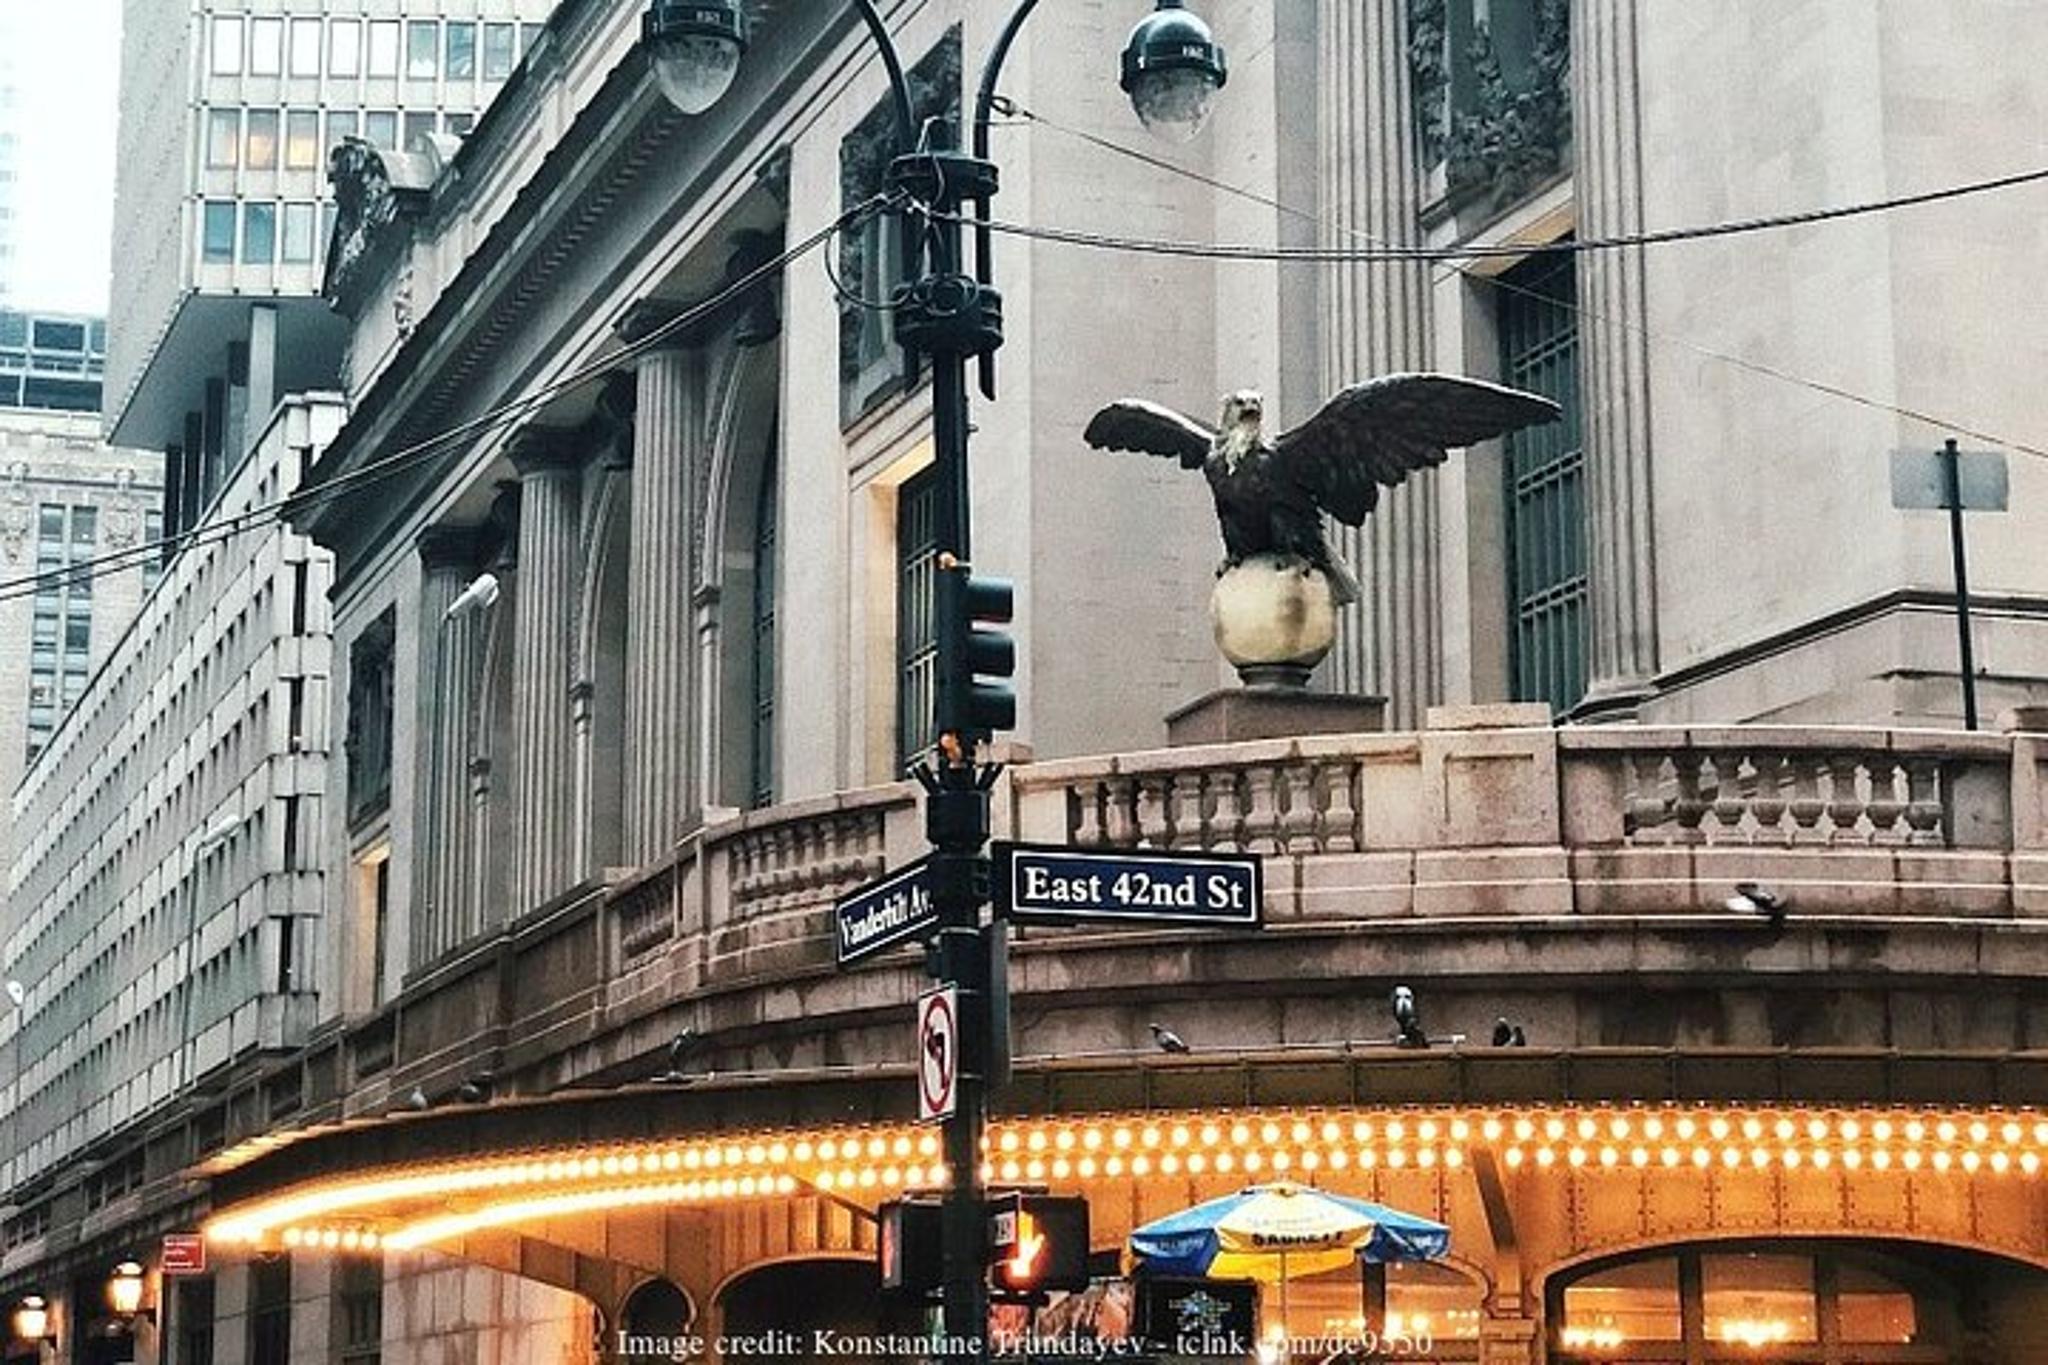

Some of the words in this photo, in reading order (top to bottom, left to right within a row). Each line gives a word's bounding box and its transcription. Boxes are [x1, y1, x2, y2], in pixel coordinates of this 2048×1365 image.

[1023, 866, 1102, 902] East
[1111, 872, 1196, 906] 42nd
[1207, 875, 1244, 908] St
[841, 892, 908, 947] Vanderbilt
